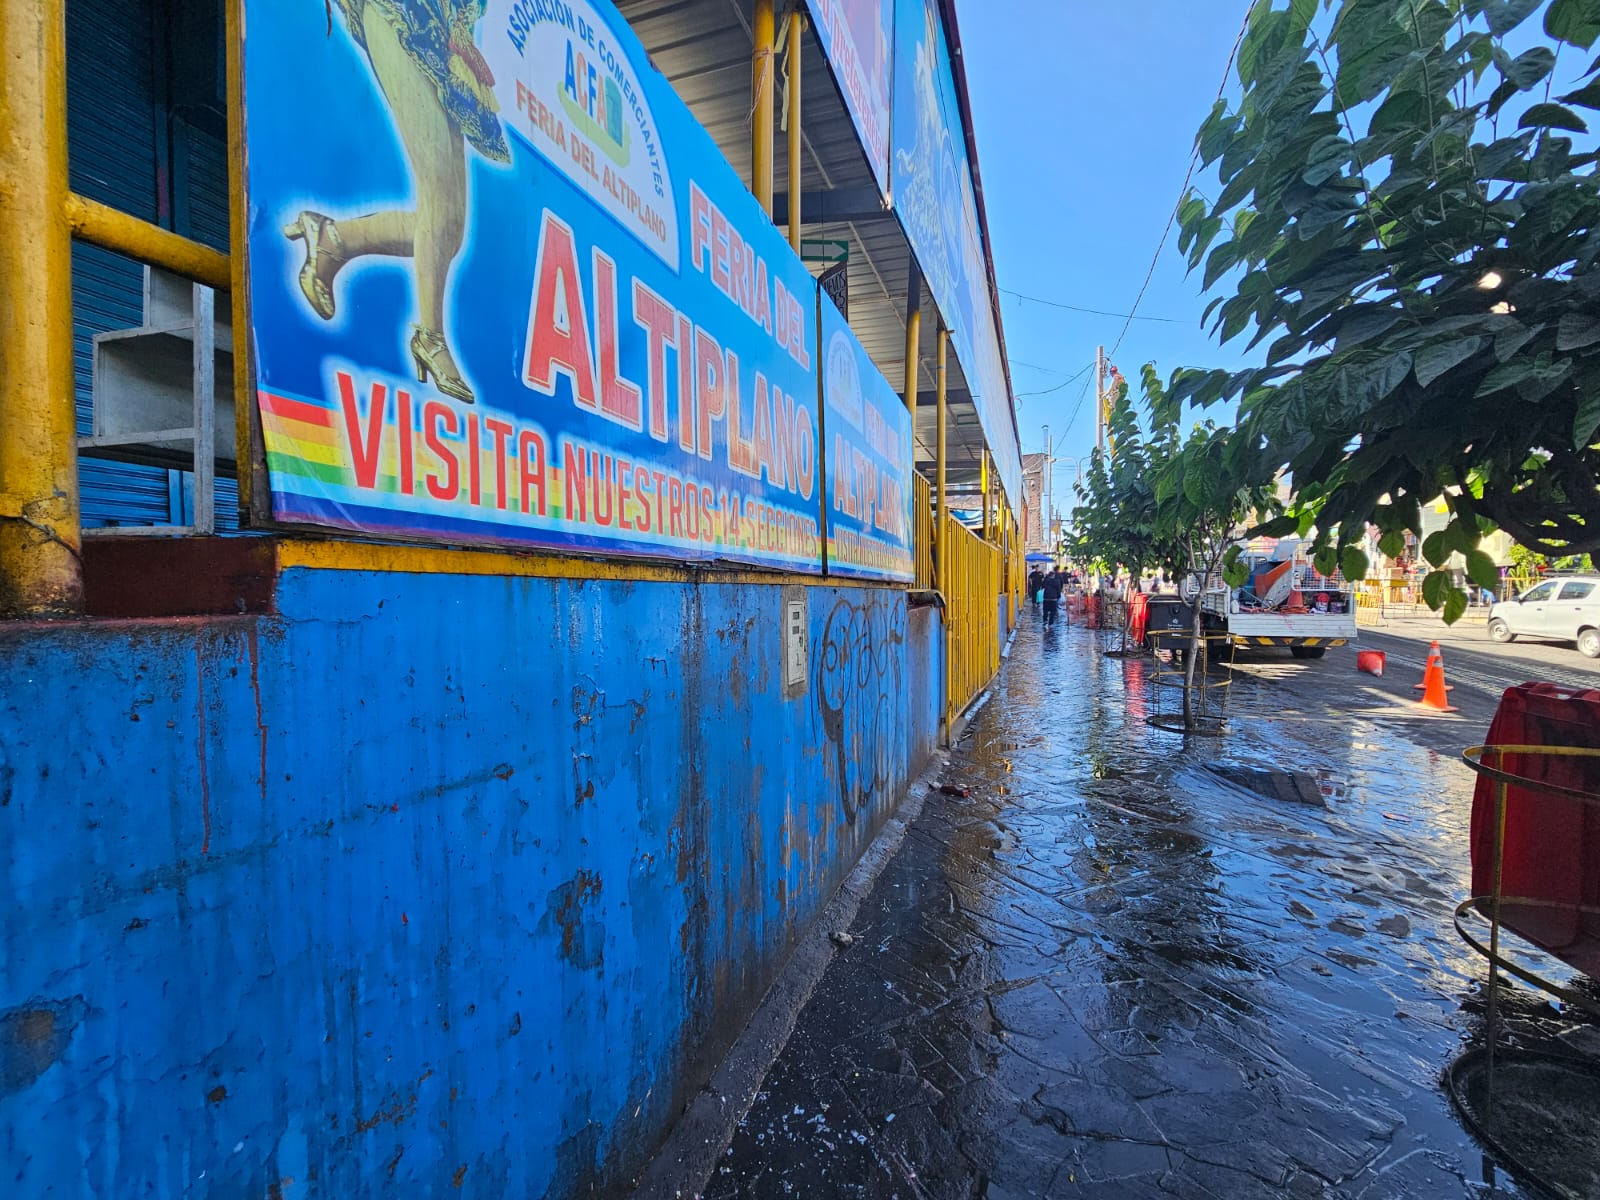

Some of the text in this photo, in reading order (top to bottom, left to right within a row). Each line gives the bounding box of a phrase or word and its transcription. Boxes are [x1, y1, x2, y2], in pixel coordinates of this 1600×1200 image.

[516, 79, 666, 243] FERIA DEL ALTIPLANO
[578, 15, 595, 50] DE
[598, 39, 665, 199] COMERCIANTES
[523, 209, 815, 500] ALTIPLANO
[690, 181, 810, 371] FERIA DEL
[338, 371, 546, 516] VISITA
[564, 441, 714, 543] NUESTROS
[720, 492, 741, 547] 14
[746, 500, 818, 559] SECCIONES
